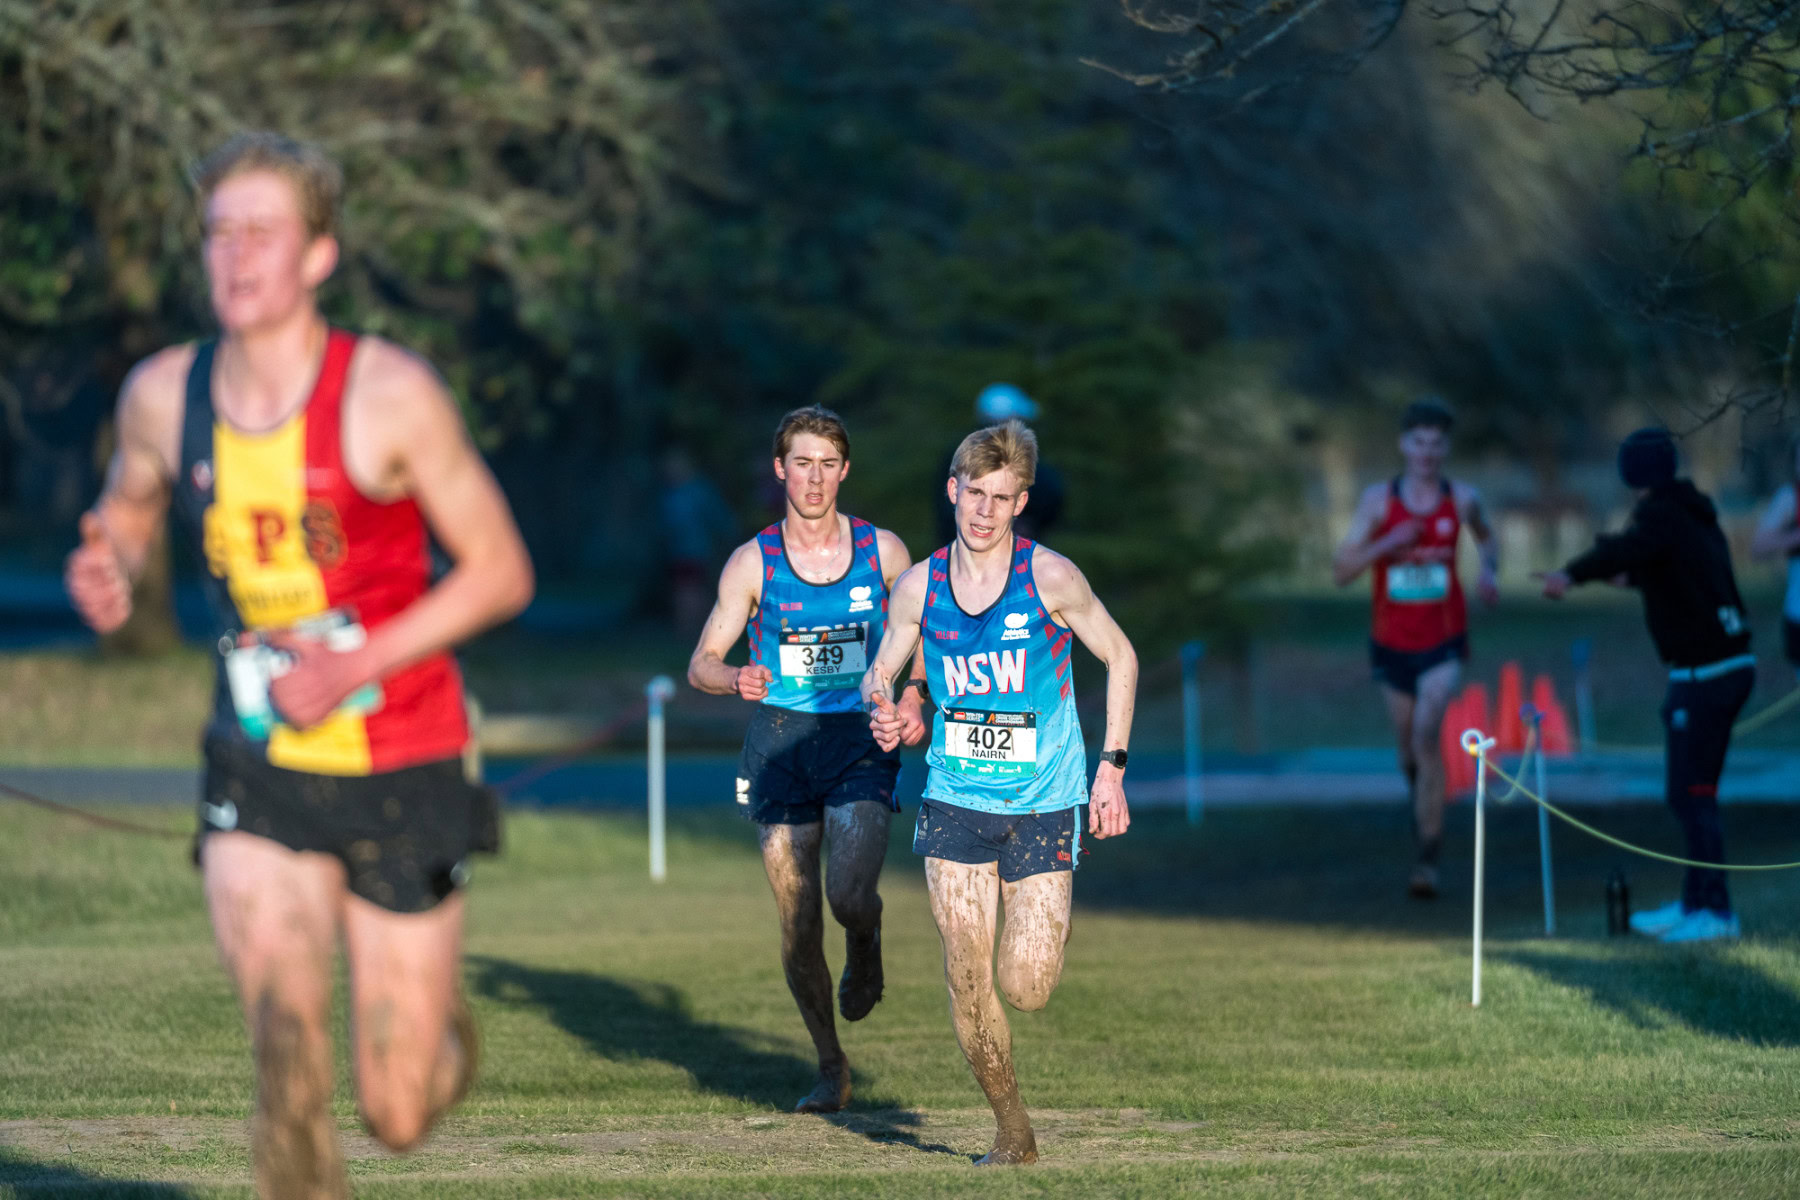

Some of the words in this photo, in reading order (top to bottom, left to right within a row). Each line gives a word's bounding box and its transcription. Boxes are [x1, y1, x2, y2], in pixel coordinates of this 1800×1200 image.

[802, 645, 844, 666] 349
[806, 665, 841, 675] KESBY
[942, 648, 1027, 697] NSW
[967, 726, 1011, 750] 402
[972, 749, 1006, 760] NAIRN
